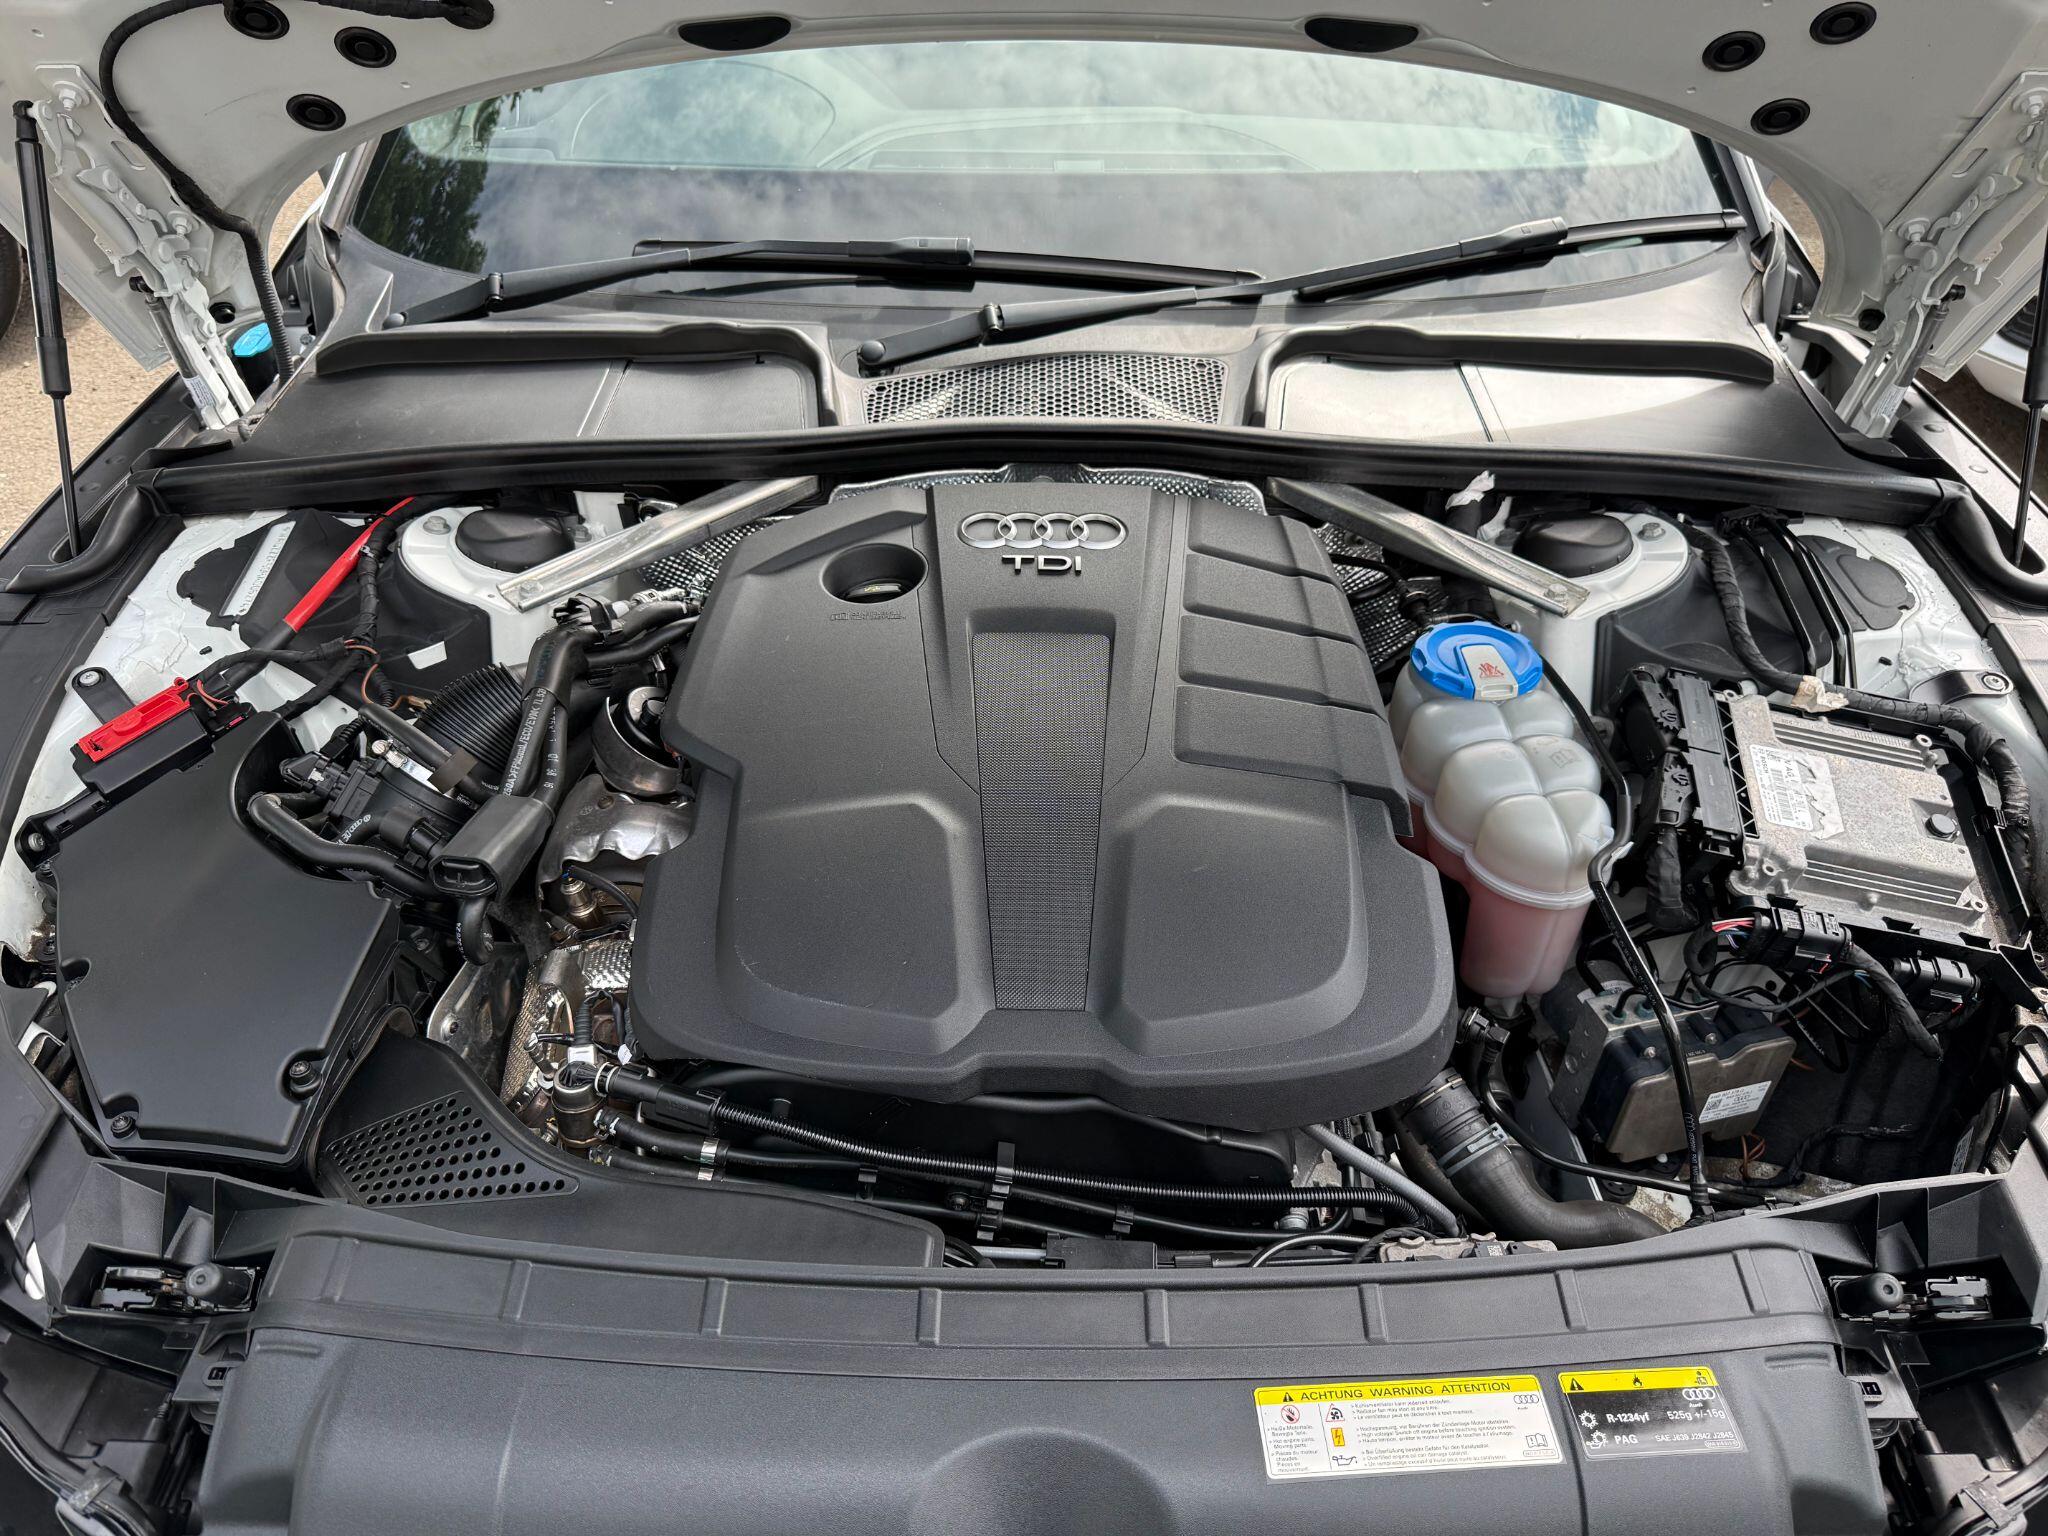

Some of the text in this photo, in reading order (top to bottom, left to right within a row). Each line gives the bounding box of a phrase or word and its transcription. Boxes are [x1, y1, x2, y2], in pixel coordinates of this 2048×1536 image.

[1001, 554, 1082, 576] TDI
[1760, 756, 1769, 774] BOSCH
[1300, 1382, 1511, 1401] ACHTUNG WARNING ATTENTION
[1605, 1408, 1726, 1424] R-1234yf 525g +/-15g
[1614, 1434, 1639, 1445] PAG
[1654, 1433, 1671, 1442] SAE
